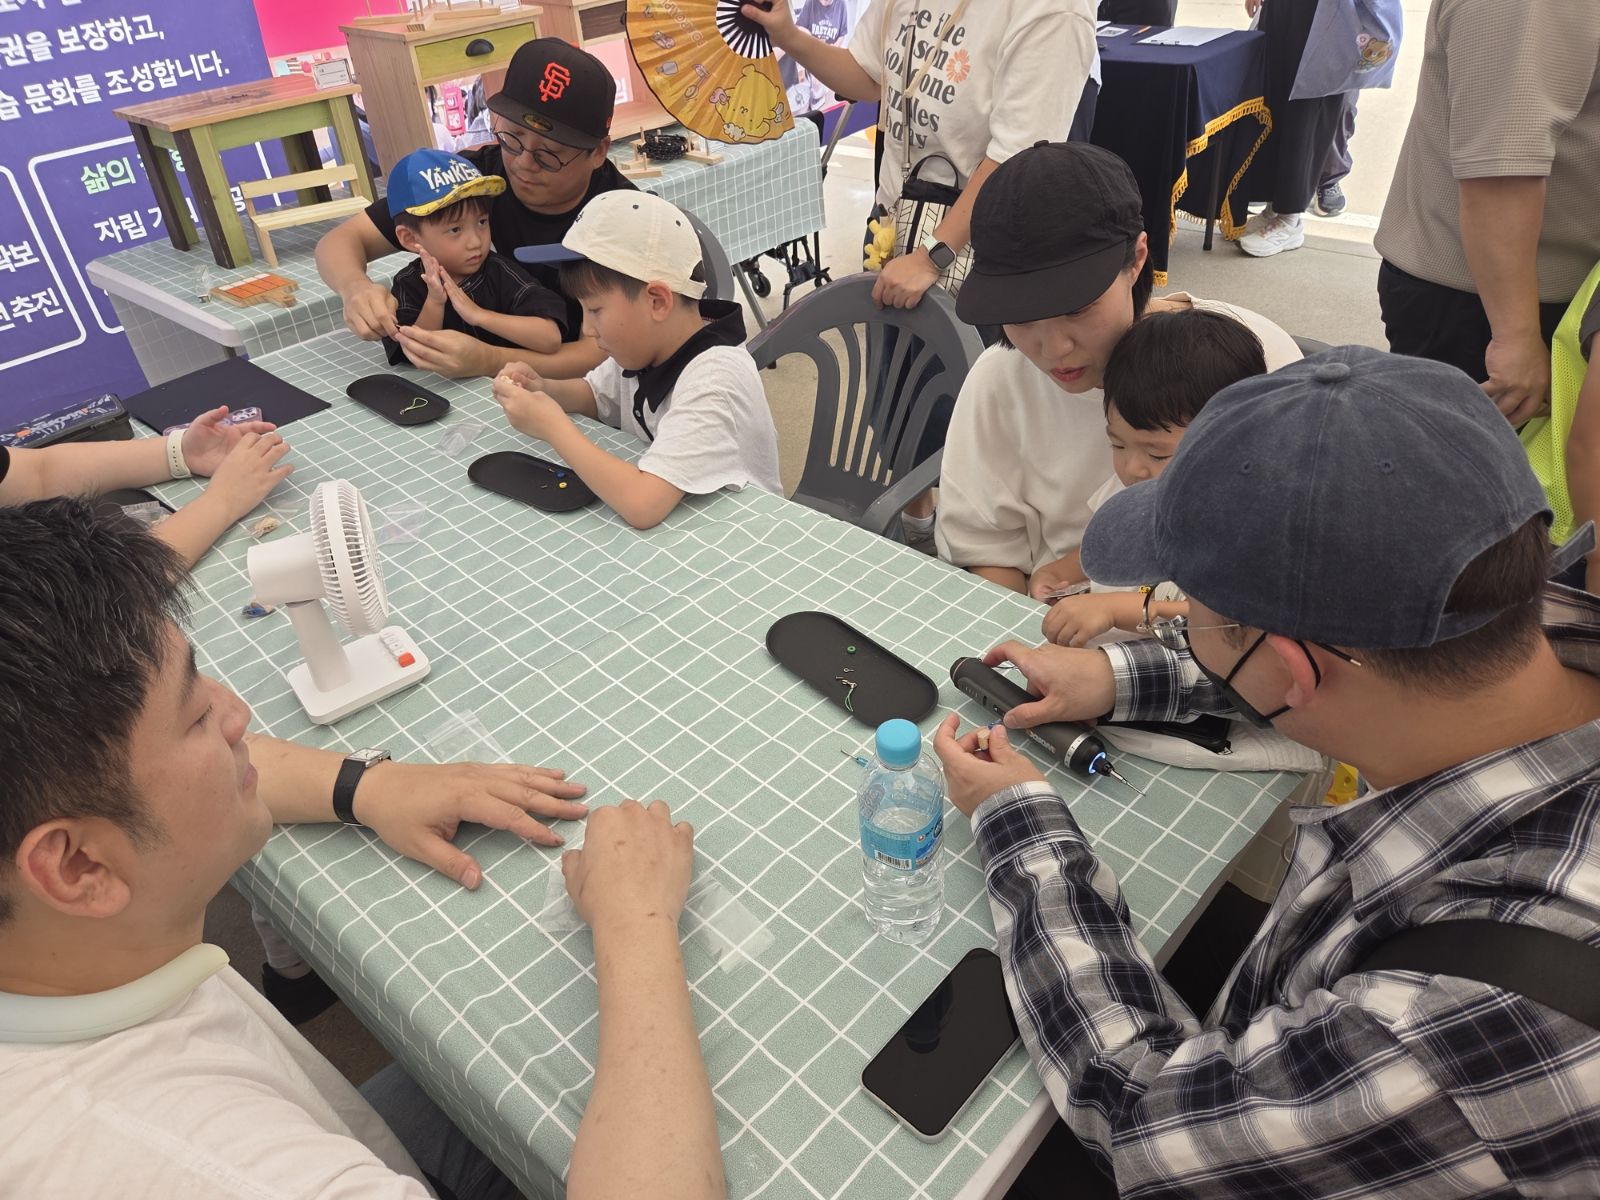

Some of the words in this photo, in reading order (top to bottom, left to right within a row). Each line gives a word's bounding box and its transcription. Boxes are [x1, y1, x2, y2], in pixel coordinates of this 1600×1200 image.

[0, 31, 54, 69] 권을
[57, 14, 165, 54] 보장하고,
[23, 73, 103, 114] 문화를
[104, 49, 230, 95] 조성합니다.
[80, 156, 137, 195] 삶의
[93, 210, 148, 243] 자립
